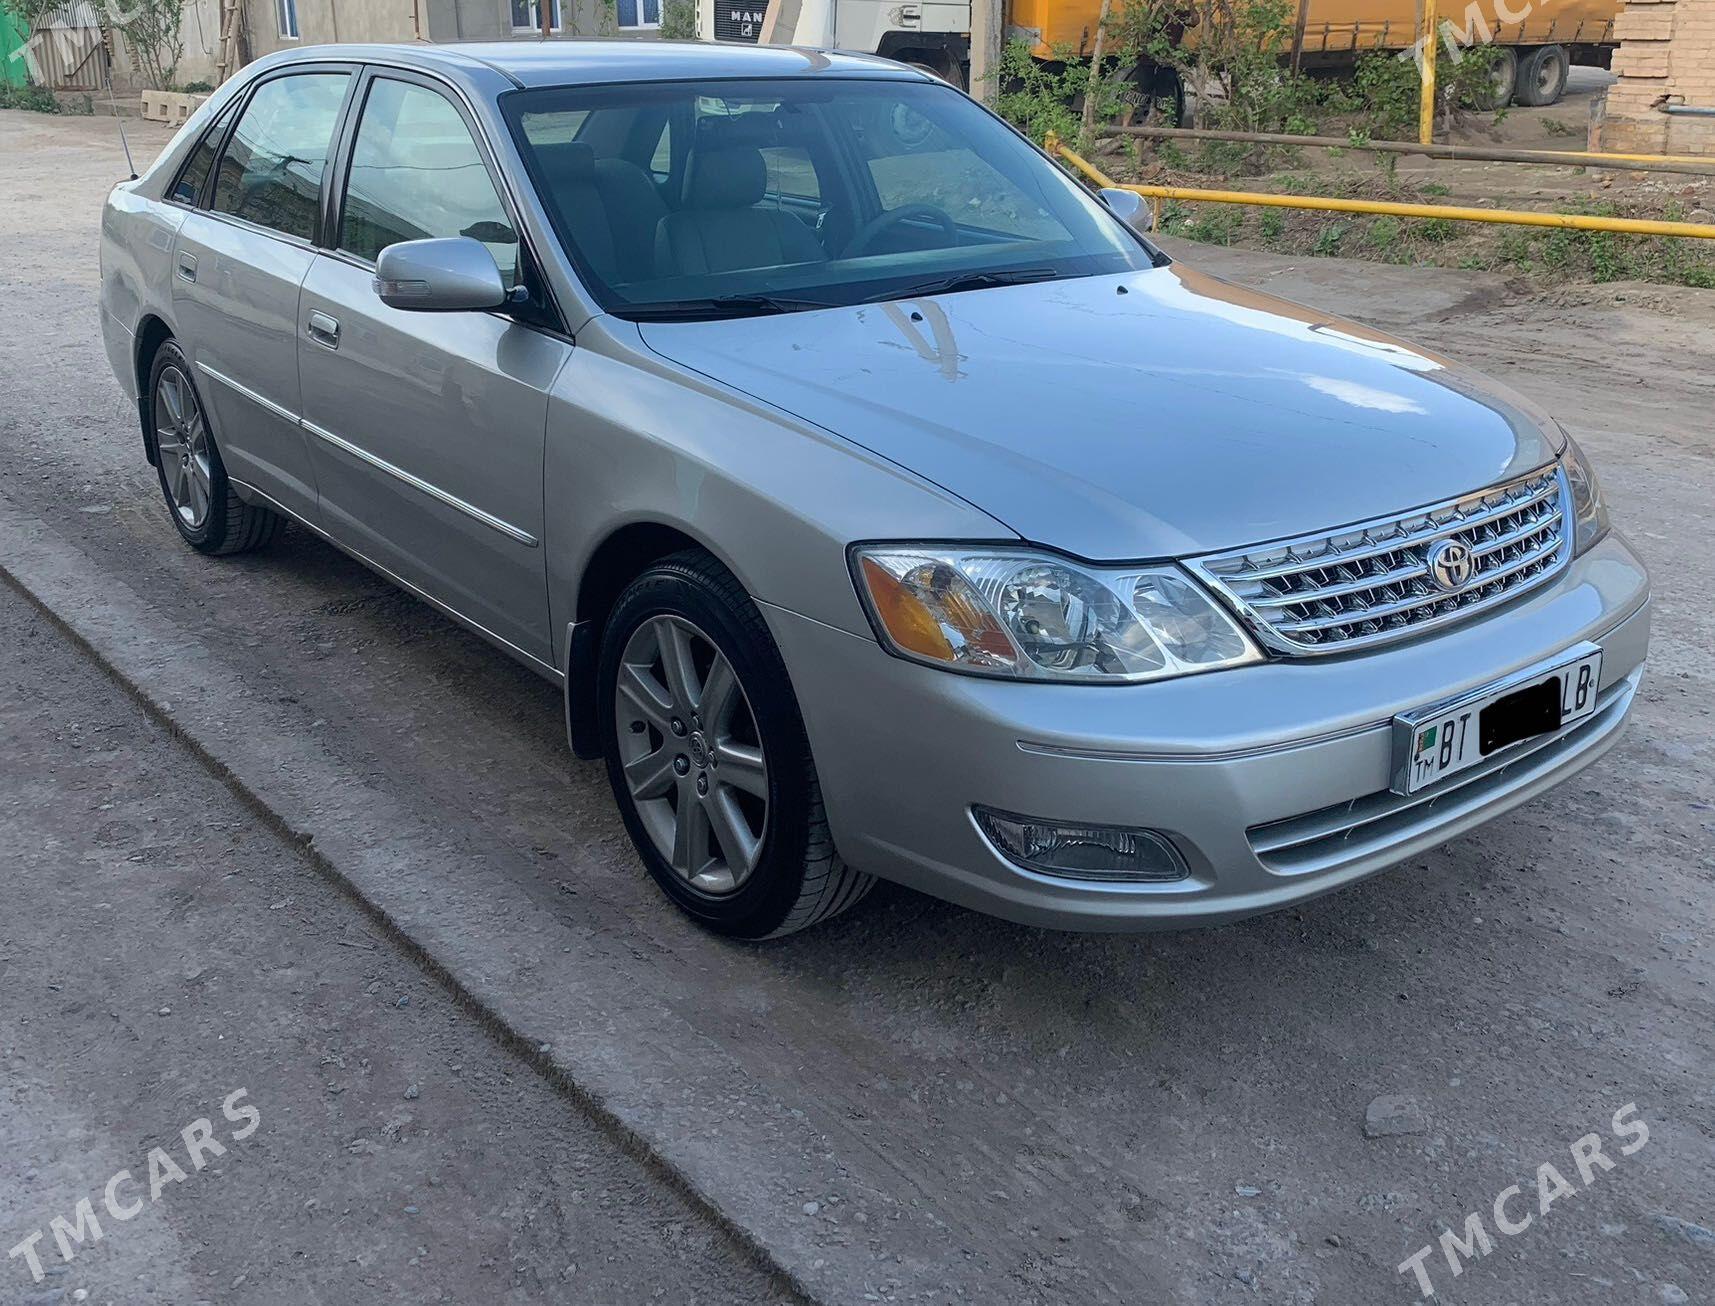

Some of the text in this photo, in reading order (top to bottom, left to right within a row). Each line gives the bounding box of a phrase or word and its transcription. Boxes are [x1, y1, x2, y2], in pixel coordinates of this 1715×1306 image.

[731, 11, 763, 22] MAN
[1439, 712, 1472, 771] BT
[1561, 664, 1591, 716] LB
[1415, 756, 1435, 783] TM
